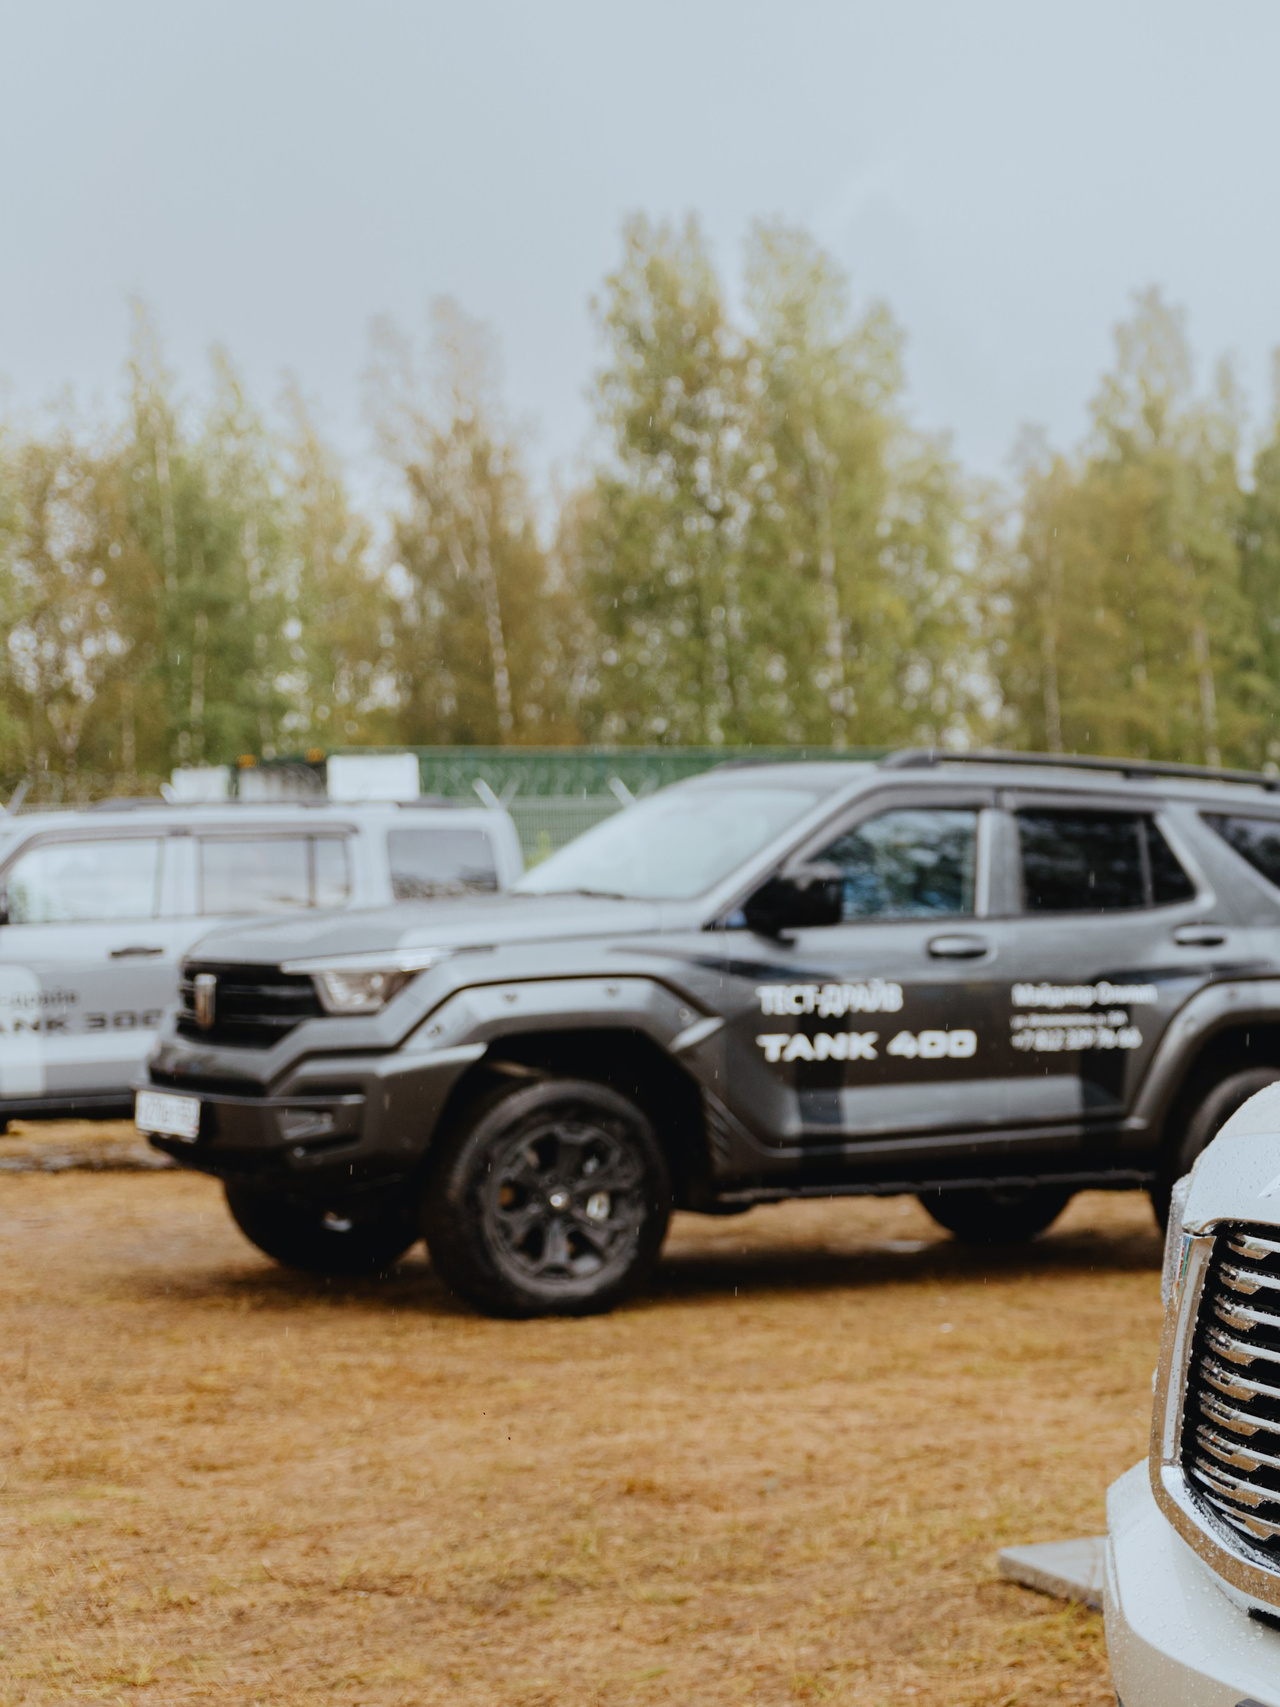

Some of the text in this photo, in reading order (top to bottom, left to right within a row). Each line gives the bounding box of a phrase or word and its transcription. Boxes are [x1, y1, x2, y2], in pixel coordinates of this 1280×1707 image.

[756, 978, 903, 1016] ТЕСТ-ДРАЙВ
[758, 1030, 977, 1062] TANK 400
